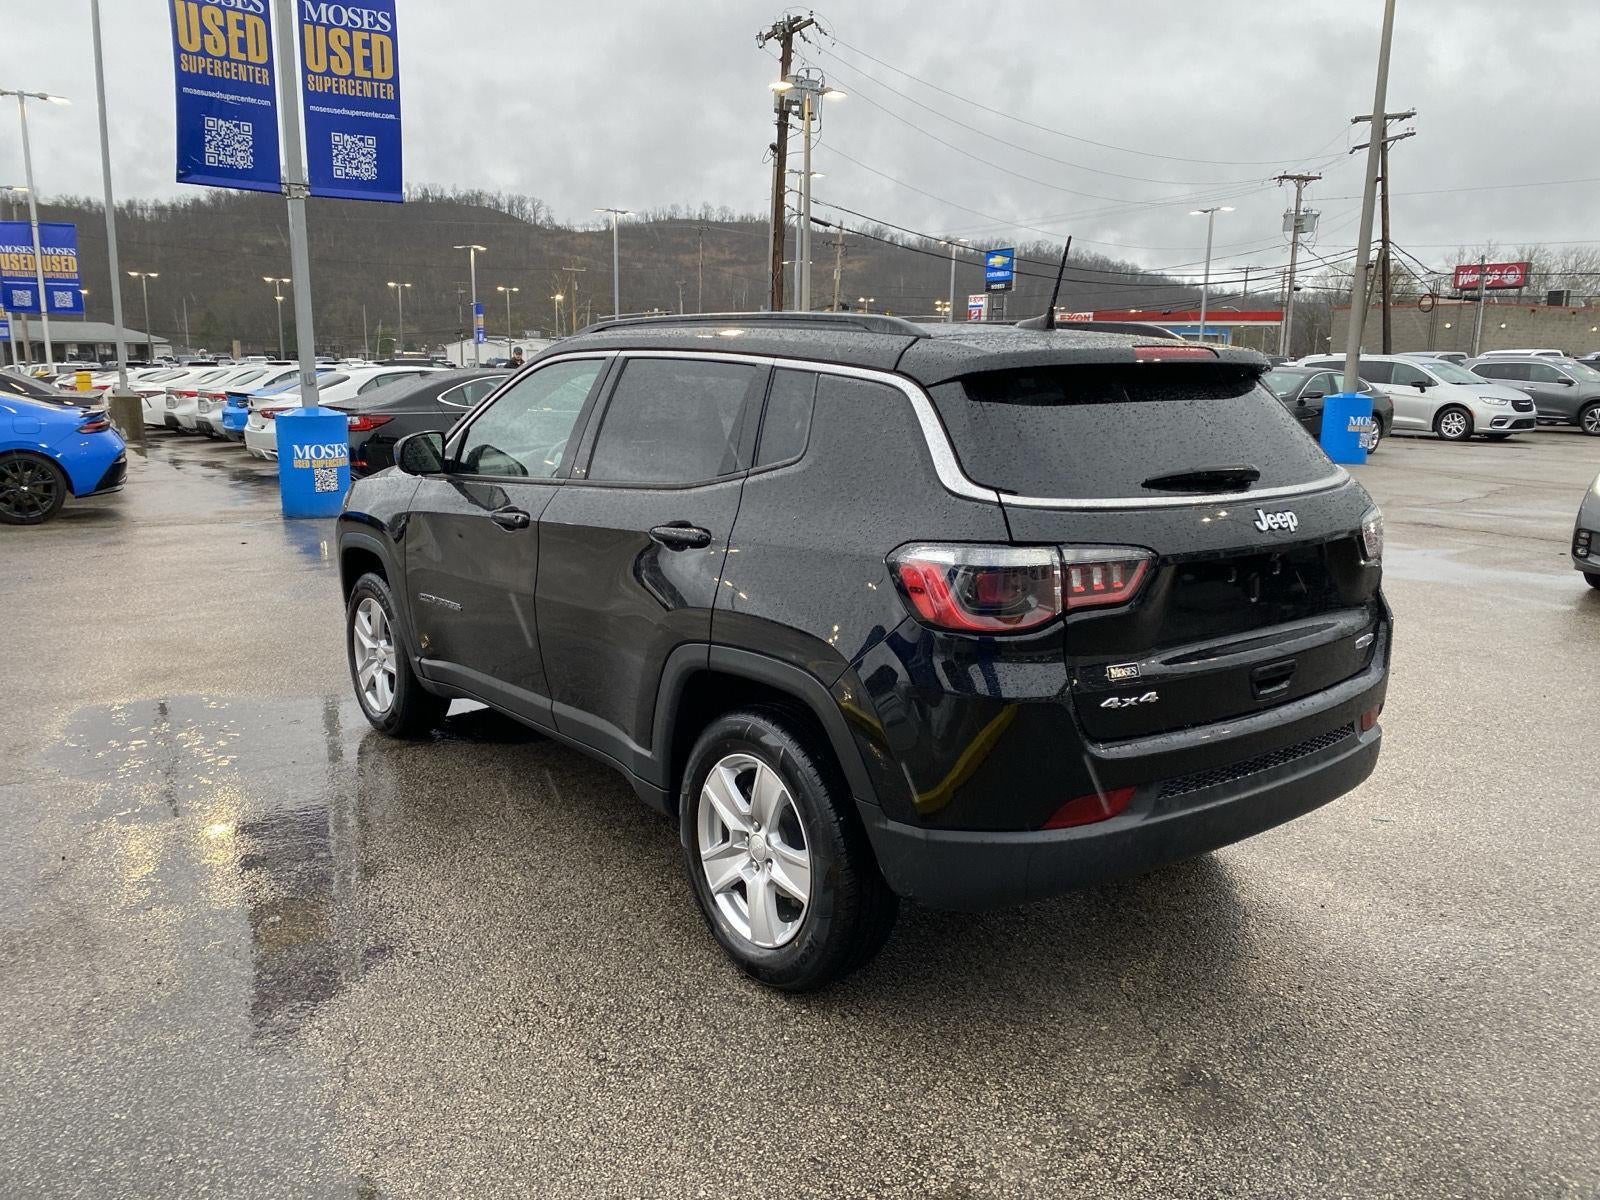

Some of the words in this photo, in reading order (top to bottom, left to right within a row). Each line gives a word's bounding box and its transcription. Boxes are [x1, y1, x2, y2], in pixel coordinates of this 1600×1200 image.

[303, 0, 391, 32] MOSES
[174, 0, 268, 64] USED
[304, 24, 394, 80] USED
[180, 54, 269, 86] SUPERCENTER
[182, 87, 271, 107] mosesusedsupercenter.com
[307, 74, 394, 100] SUPERCENTER
[309, 105, 396, 120] mosesusedsupercenter.com
[0, 245, 34, 254] MOSES
[41, 247, 76, 256] MOSES
[0, 253, 36, 270] USED
[42, 255, 77, 273] USED
[1459, 266, 1501, 286] Weny's
[292, 443, 348, 459] MOSES
[1255, 508, 1298, 532] Jeep
[1100, 691, 1159, 709] 4x4
